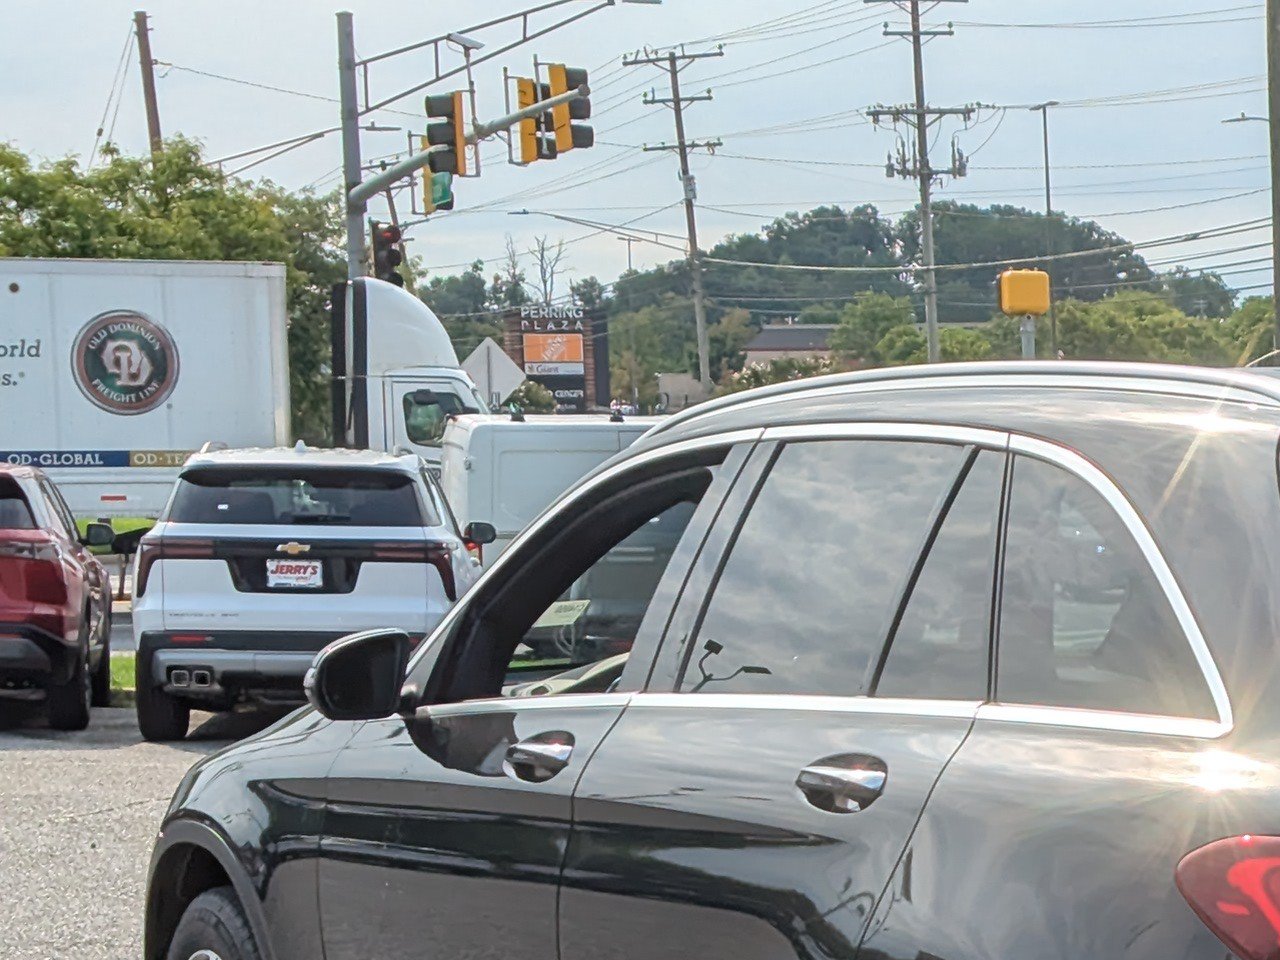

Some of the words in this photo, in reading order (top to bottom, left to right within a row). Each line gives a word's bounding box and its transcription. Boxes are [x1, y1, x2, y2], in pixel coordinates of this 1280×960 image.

[520, 305, 584, 318] PERRING
[521, 320, 583, 330] PLAZA
[88, 328, 108, 349] OLD
[108, 322, 161, 350] DOMINION
[91, 378, 139, 403] FREIGHT
[139, 381, 161, 400] LINE
[270, 564, 319, 575] JERRY'S
